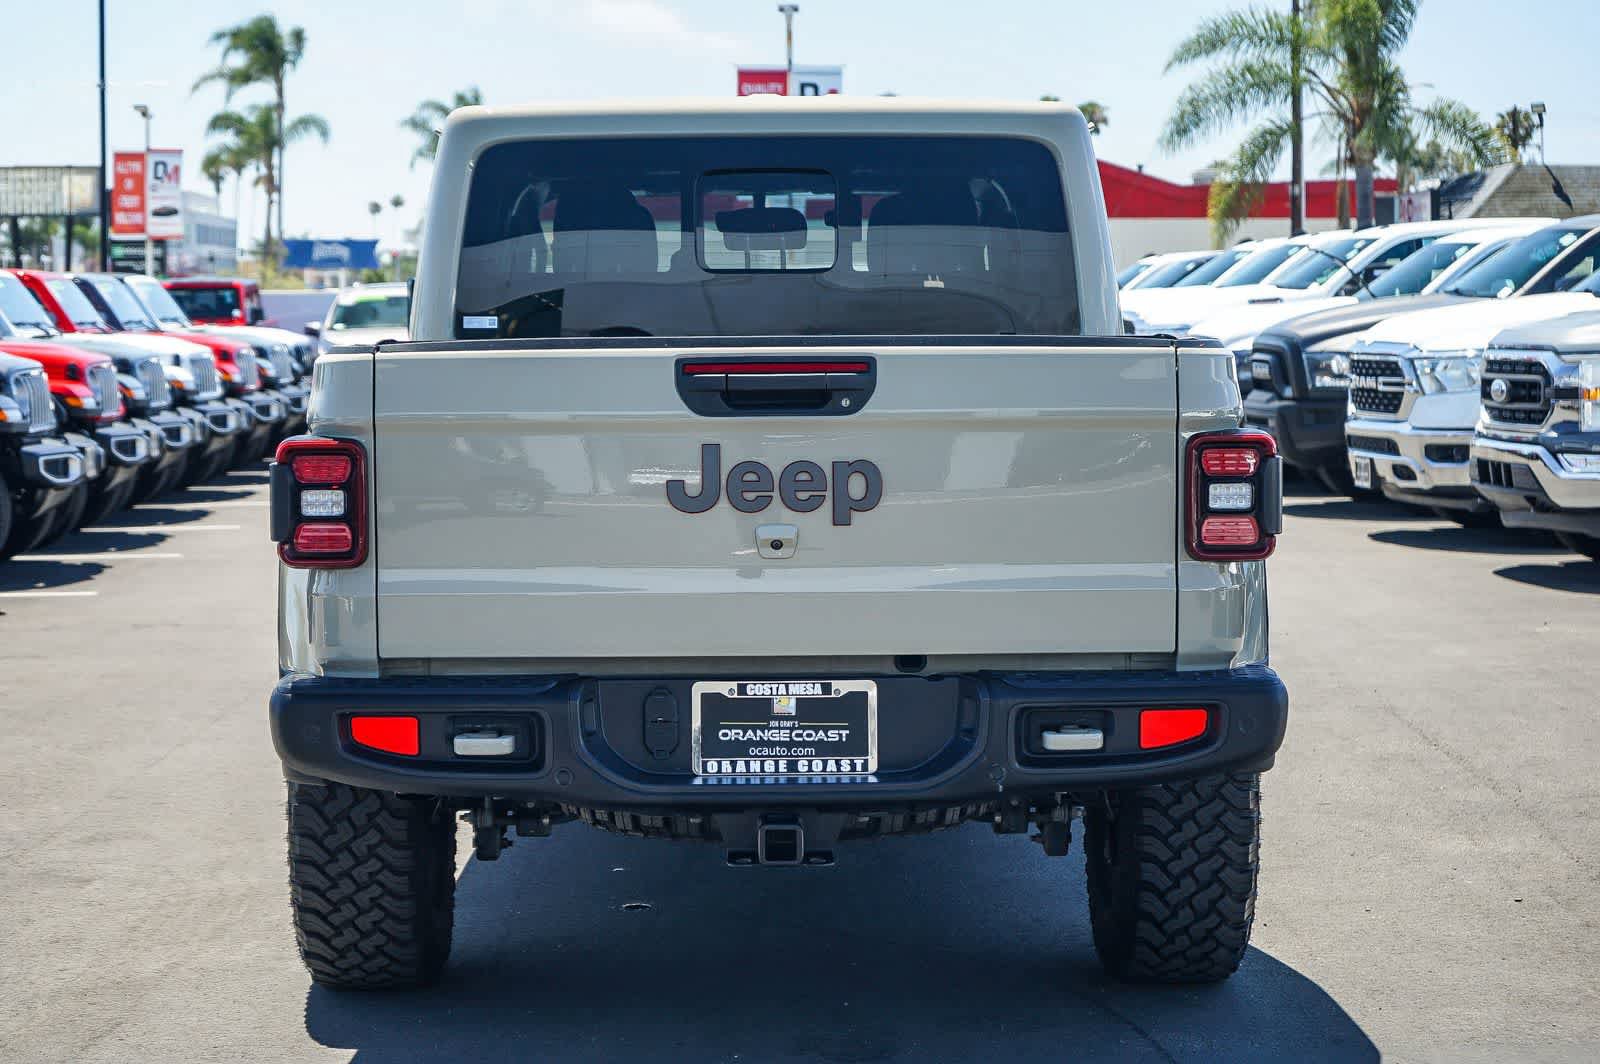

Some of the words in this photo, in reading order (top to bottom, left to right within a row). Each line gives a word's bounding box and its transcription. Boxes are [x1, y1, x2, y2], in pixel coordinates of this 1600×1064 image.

[666, 443, 883, 526] Jeep
[746, 683, 787, 696] COSTA
[788, 683, 822, 696] MESA
[749, 746, 815, 756] ocauto.com
[706, 759, 788, 774] ORANGE
[797, 759, 864, 773] COAST
